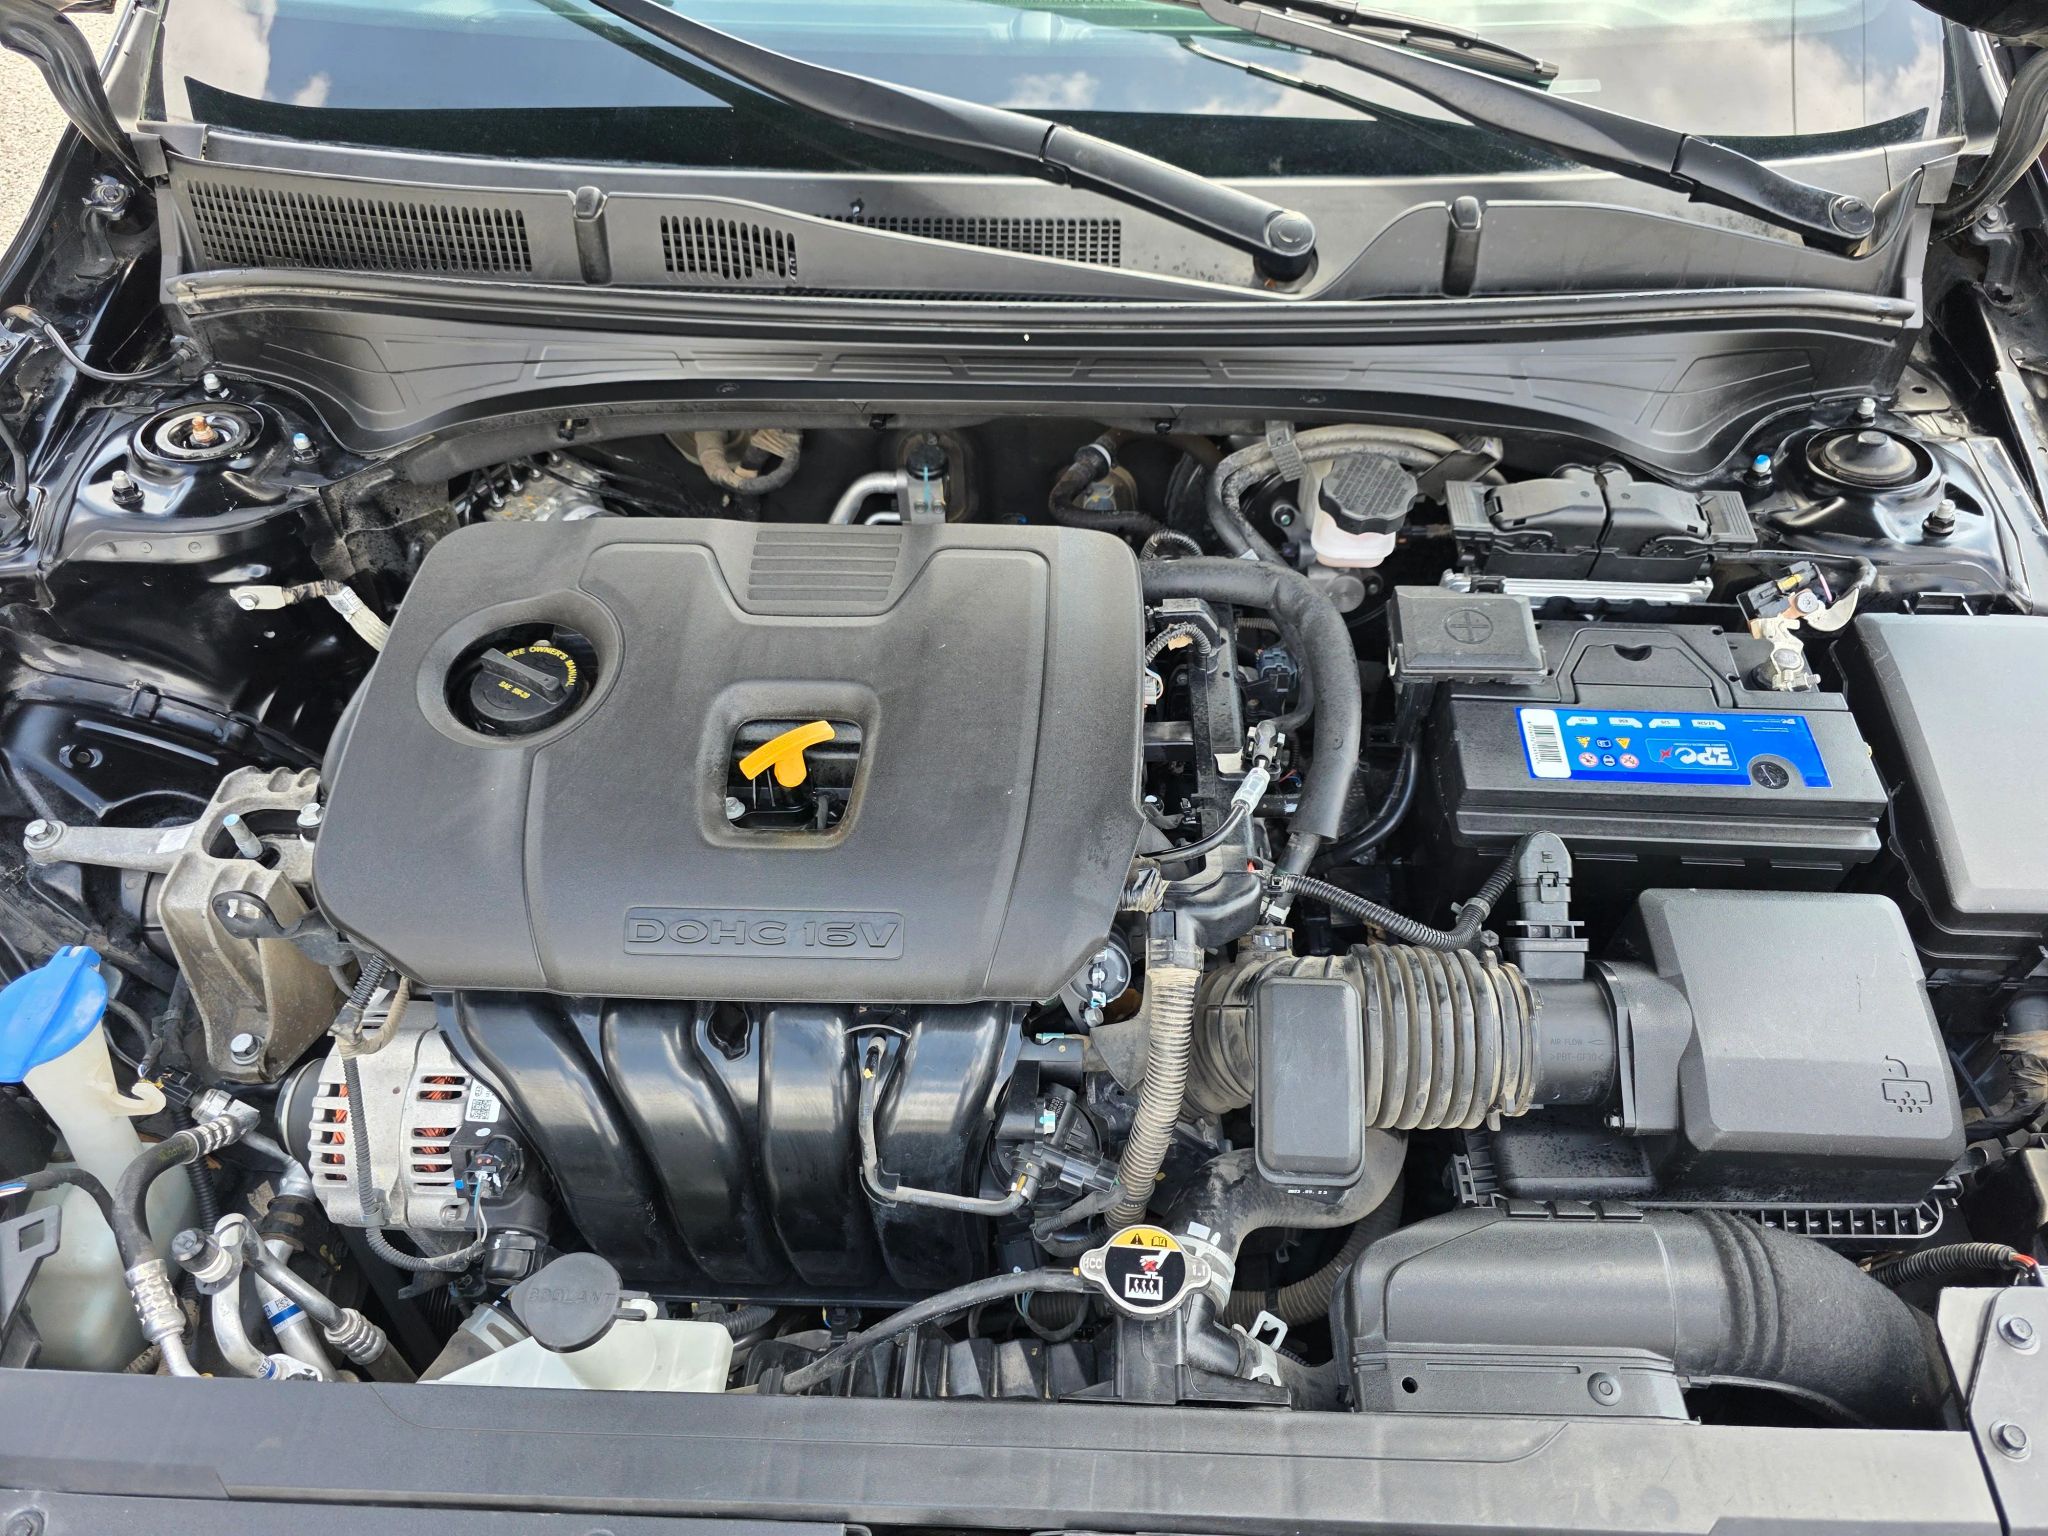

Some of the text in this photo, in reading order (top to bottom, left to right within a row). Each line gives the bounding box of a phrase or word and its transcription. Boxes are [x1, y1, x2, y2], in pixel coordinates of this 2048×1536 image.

[506, 646, 578, 688] SEE OWNER'S MANUAL
[627, 917, 899, 949] DOHC 16V
[1083, 1256, 1103, 1270] HCC
[1191, 1264, 1206, 1277] 1.1
